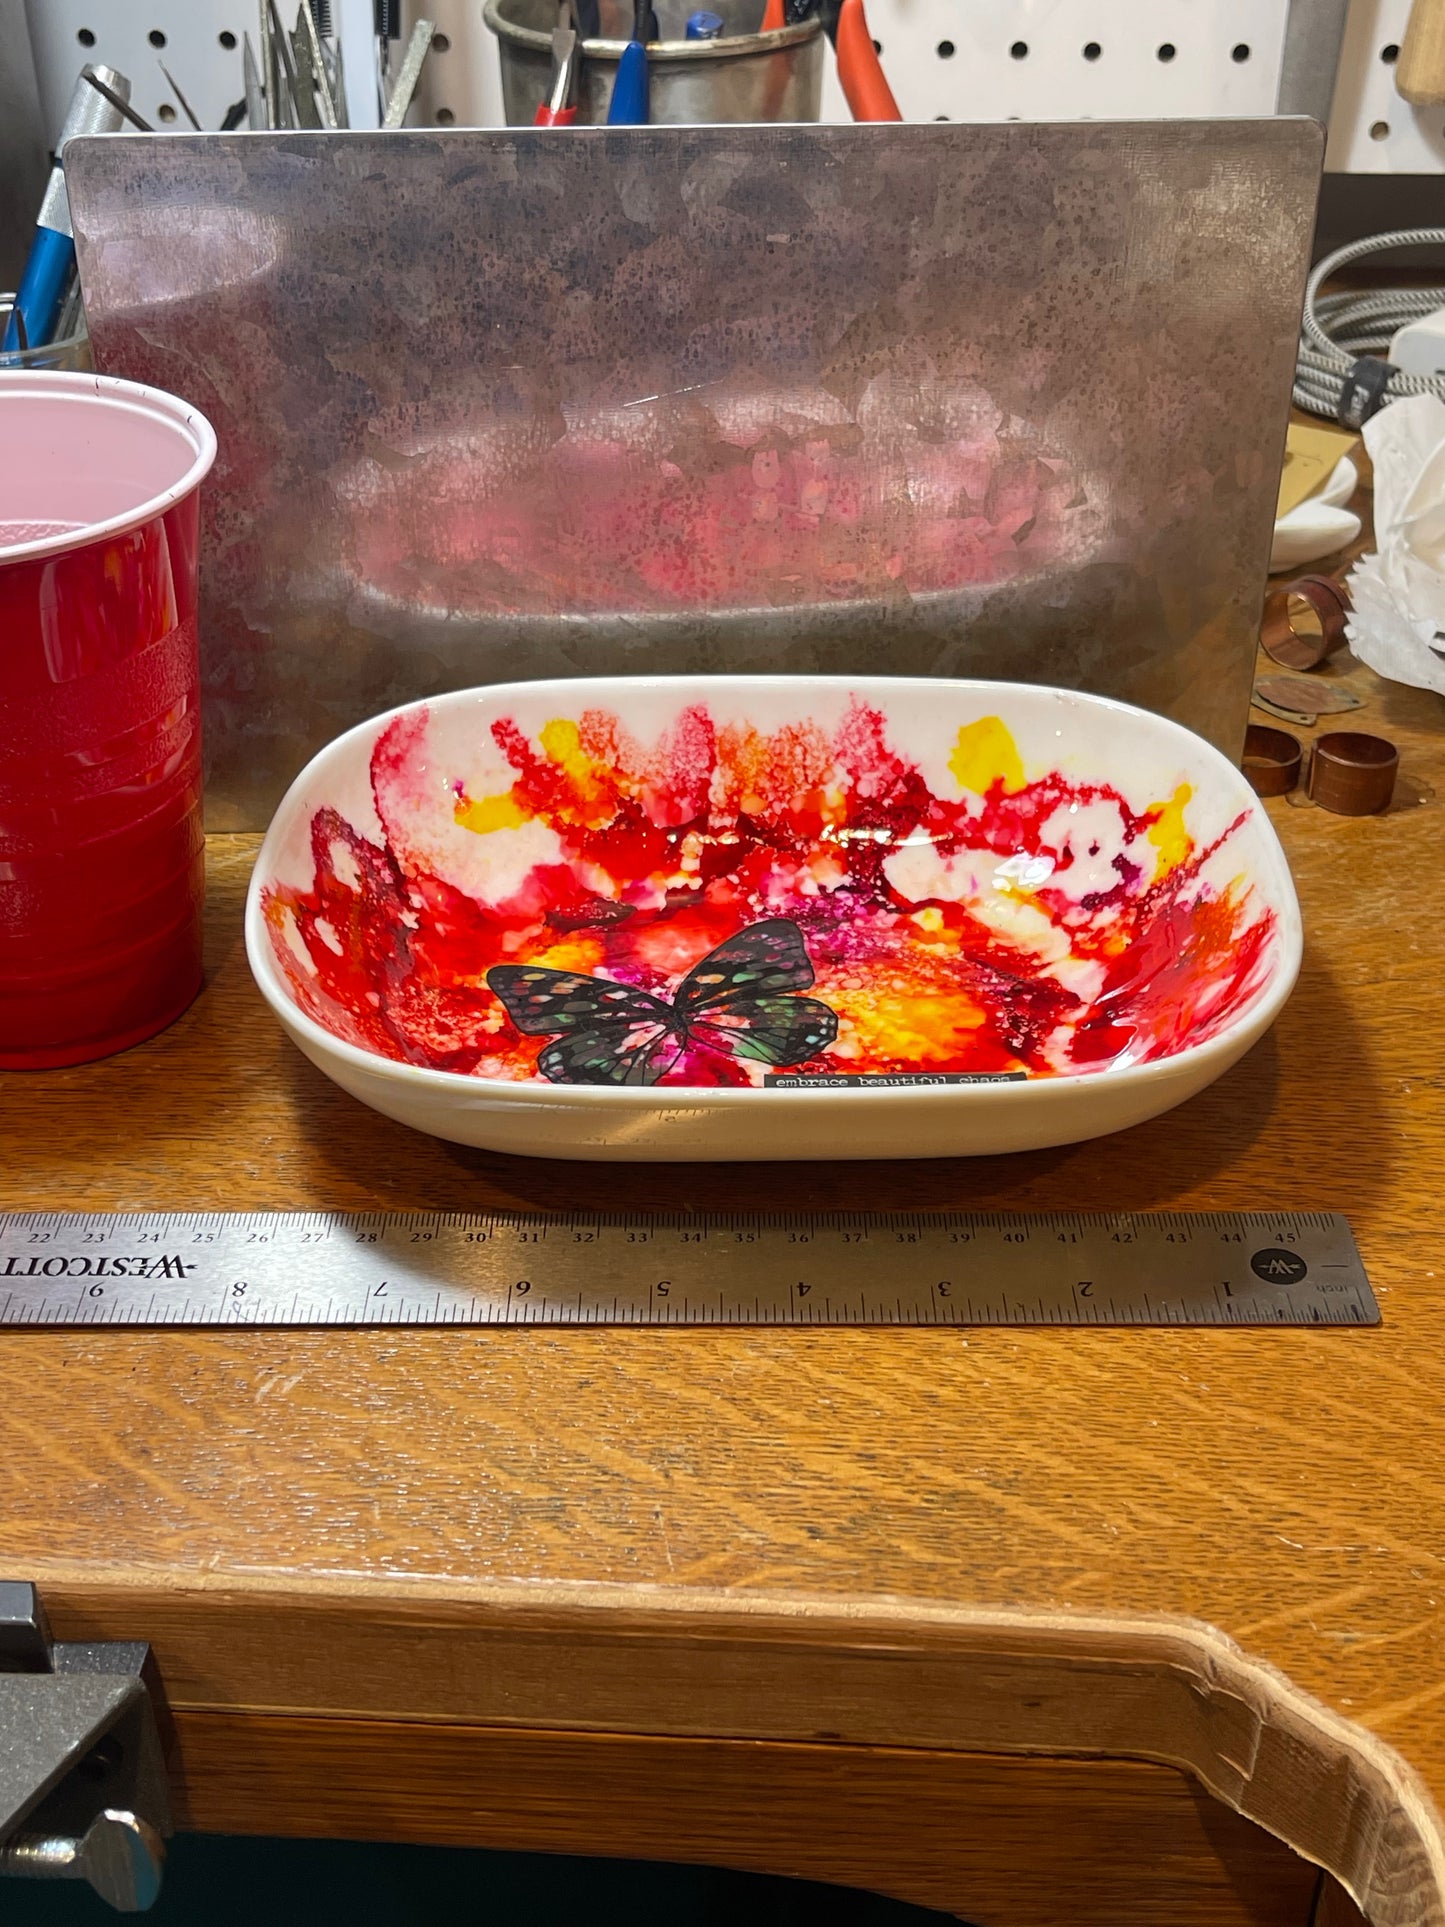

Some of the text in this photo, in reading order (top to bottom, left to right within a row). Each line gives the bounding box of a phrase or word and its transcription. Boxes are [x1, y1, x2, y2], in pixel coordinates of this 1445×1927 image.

[776, 1077, 848, 1087] embrace
[857, 1076, 947, 1087] beautiful
[27, 1233, 1296, 1243] 22 23 24 25 26 27 28 29 30 31 32 33 34 35 36 37 38 39 40 41 42 43 44 45
[0, 1255, 190, 1279] WESTCOTT
[89, 1281, 1234, 1297] 1 2 3 4 5 6 7 8 9
[1316, 1284, 1349, 1294] inch
